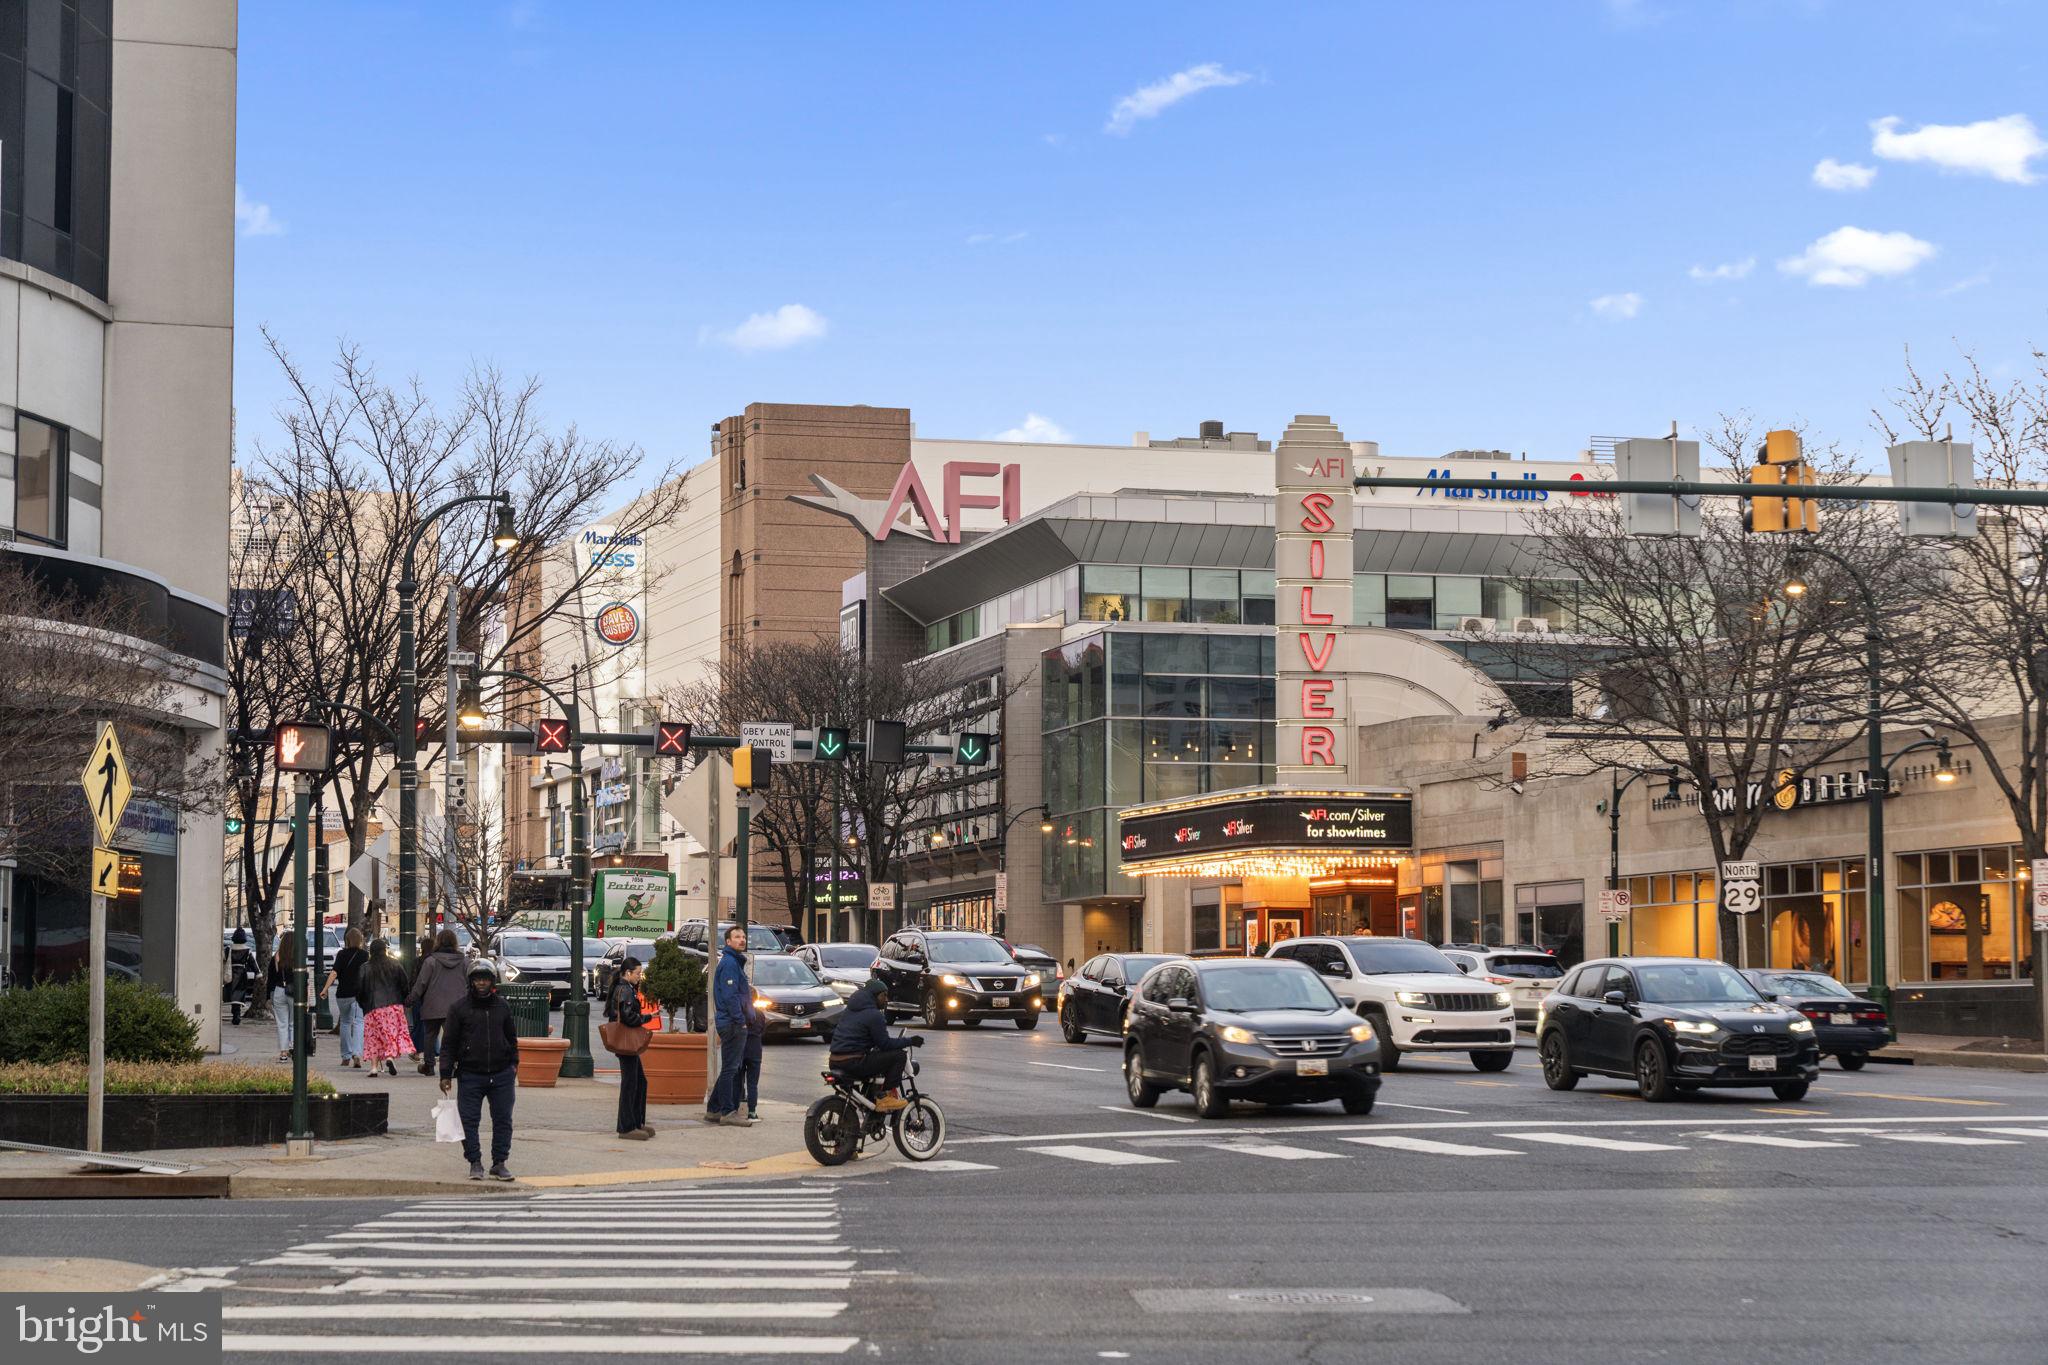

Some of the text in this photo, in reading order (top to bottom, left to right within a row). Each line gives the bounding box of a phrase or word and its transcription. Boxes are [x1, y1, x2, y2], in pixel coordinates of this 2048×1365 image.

[1308, 457, 1345, 478] AFI
[875, 459, 1021, 544] AFI
[602, 611, 626, 625] DAVE
[1299, 492, 1335, 765] SILVER
[743, 727, 791, 737] OBEY LANE
[747, 738, 786, 748] CONTROL
[1803, 770, 1867, 802] BREA
[1309, 807, 1386, 824] AFI.com/Silver
[1307, 824, 1387, 839] for showtimes
[1725, 865, 1757, 876] NORTH
[606, 881, 668, 892] Peter Pan
[1728, 887, 1756, 906] 29
[606, 924, 665, 933] PeterPanBus.com
